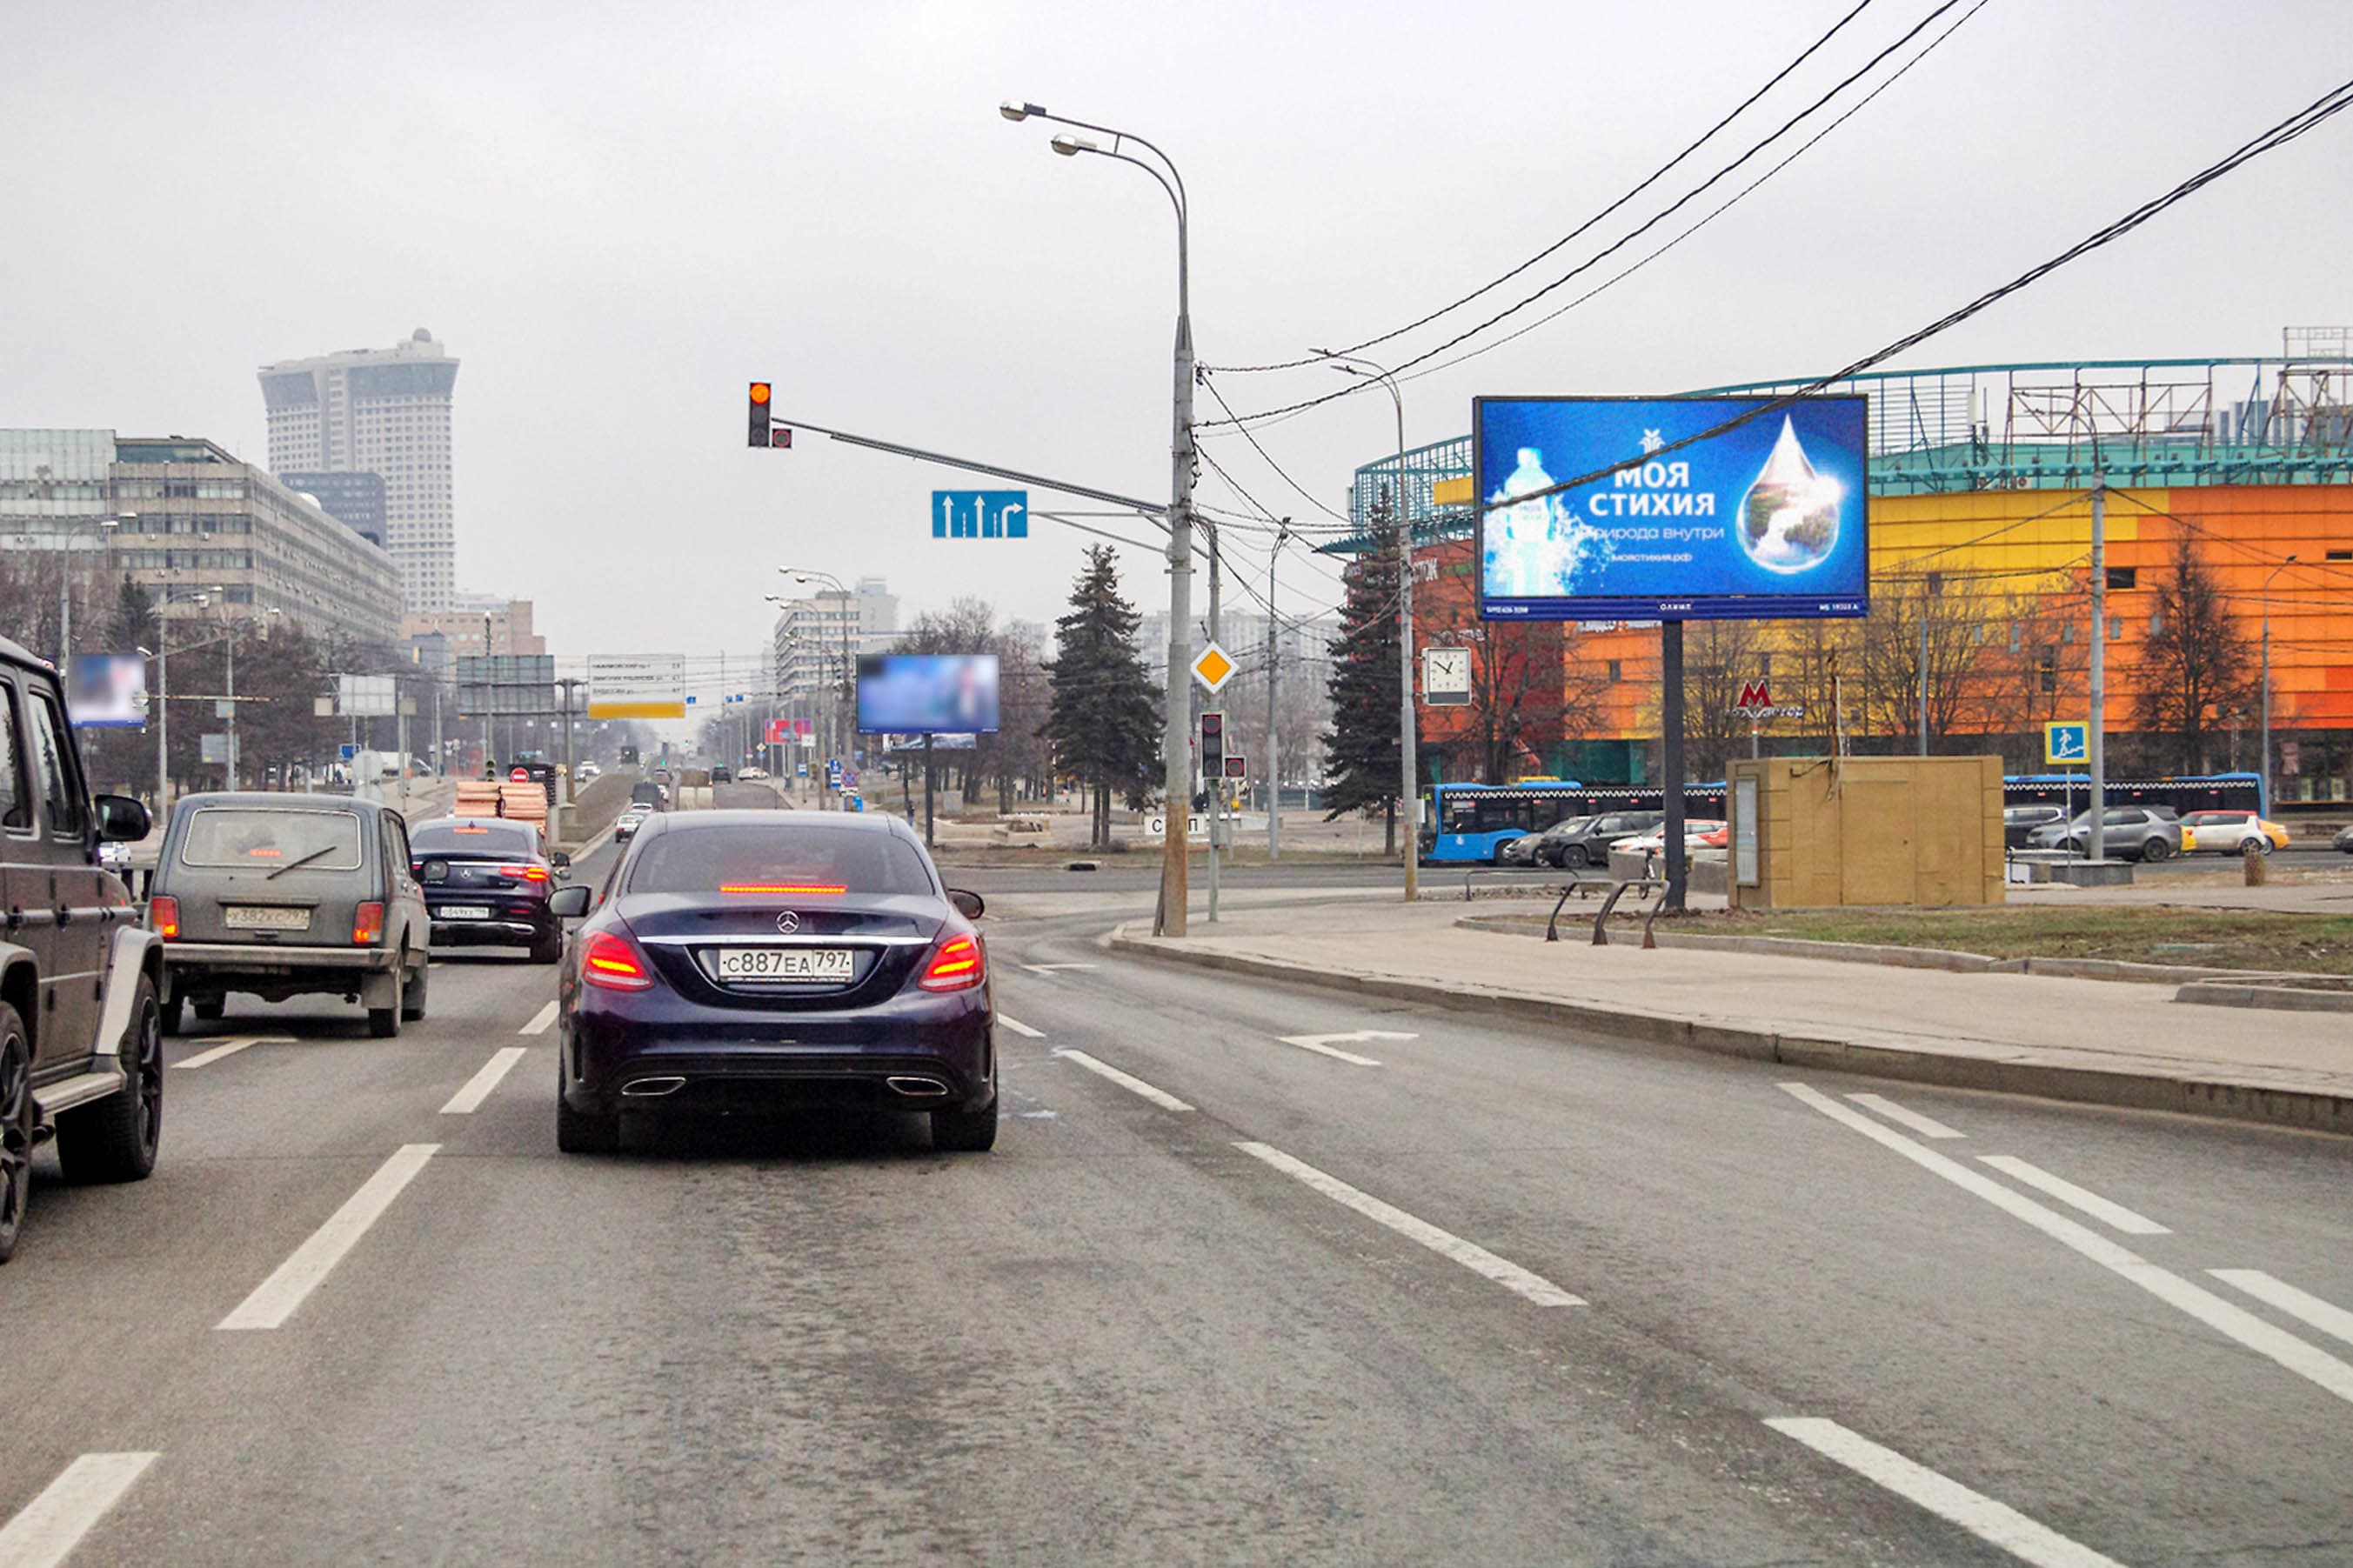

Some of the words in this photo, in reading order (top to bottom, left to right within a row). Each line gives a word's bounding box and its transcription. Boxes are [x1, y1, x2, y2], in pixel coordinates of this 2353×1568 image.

[1614, 461, 1689, 488] МОЯ
[1588, 492, 1715, 516] СТИХИЯ
[1580, 526, 1660, 541] рирода
[1662, 527, 1725, 542] внутри
[1736, 679, 1774, 707] М
[1152, 818, 1198, 833] СП
[727, 952, 811, 973] С887ЕА
[815, 951, 847, 968] 797
